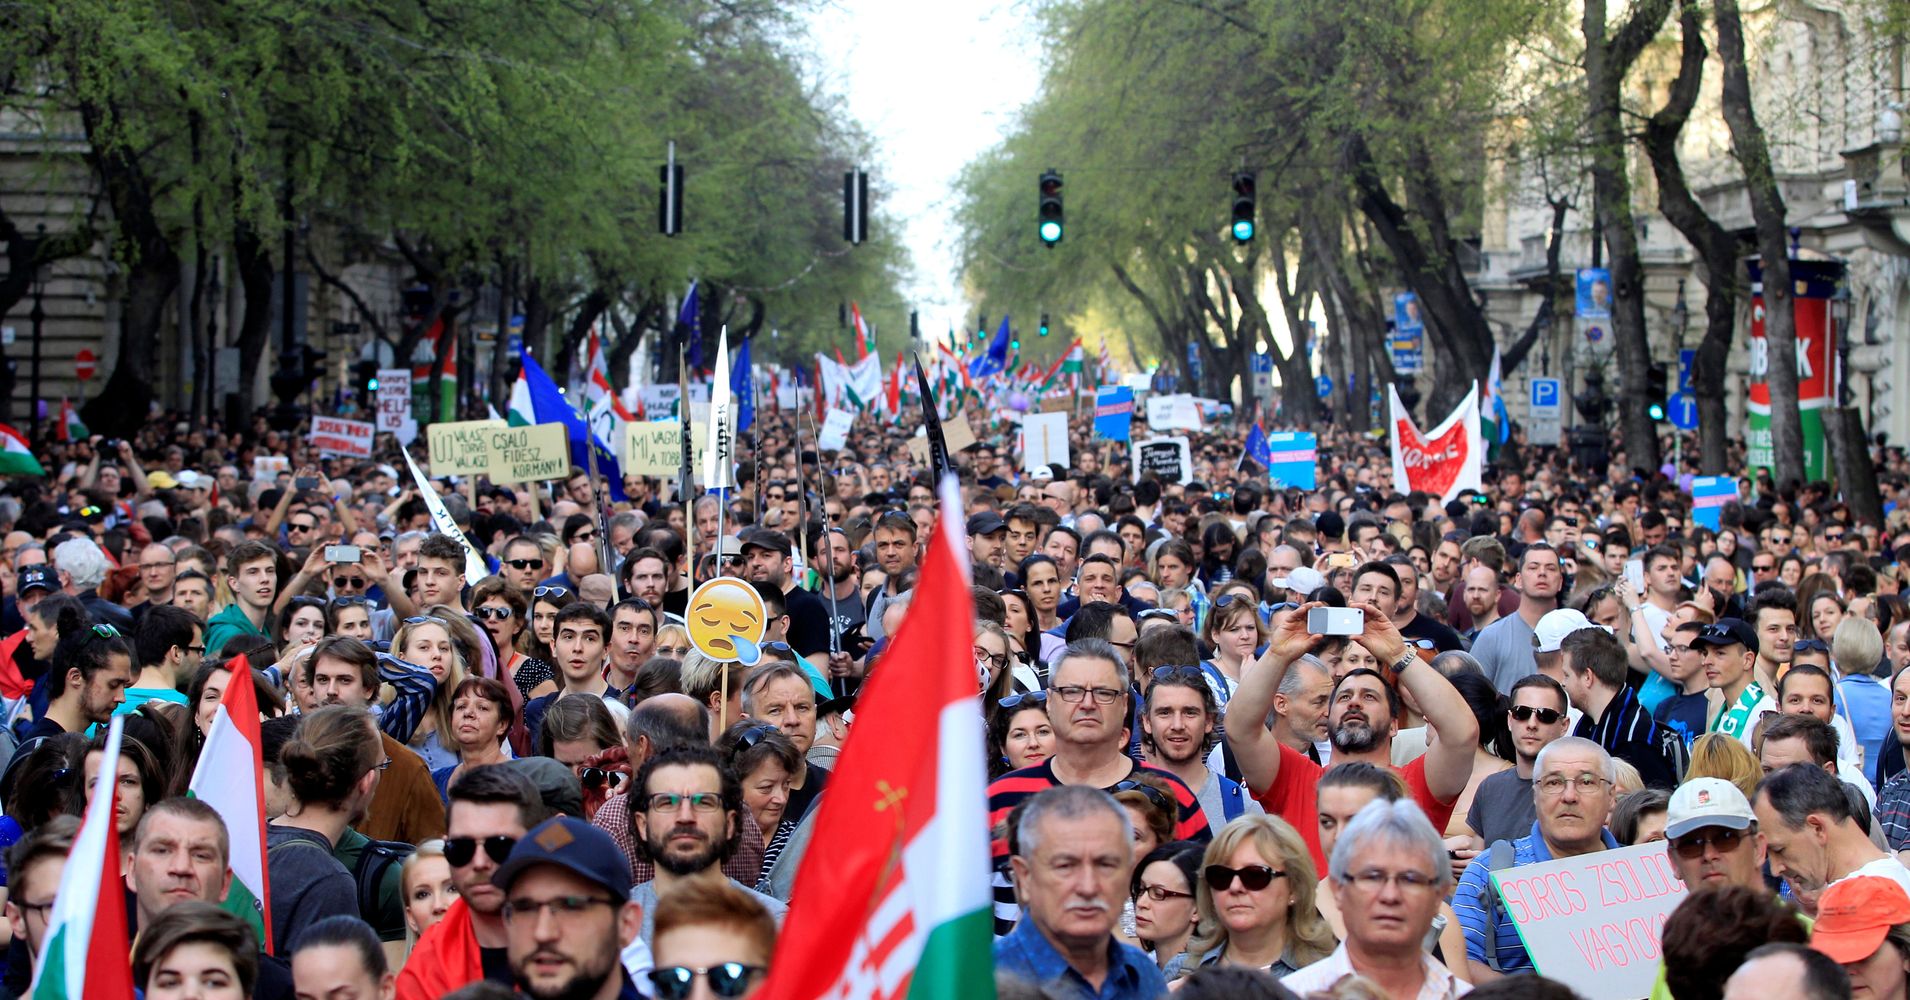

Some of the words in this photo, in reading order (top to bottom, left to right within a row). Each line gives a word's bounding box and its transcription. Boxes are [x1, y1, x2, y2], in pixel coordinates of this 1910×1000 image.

[1536, 383, 1553, 404] P
[504, 448, 541, 463] FIDESZ
[1501, 870, 1587, 924] SOROS
[1585, 853, 1687, 907] ZSOLDO
[1569, 912, 1669, 972] VAGYOK
